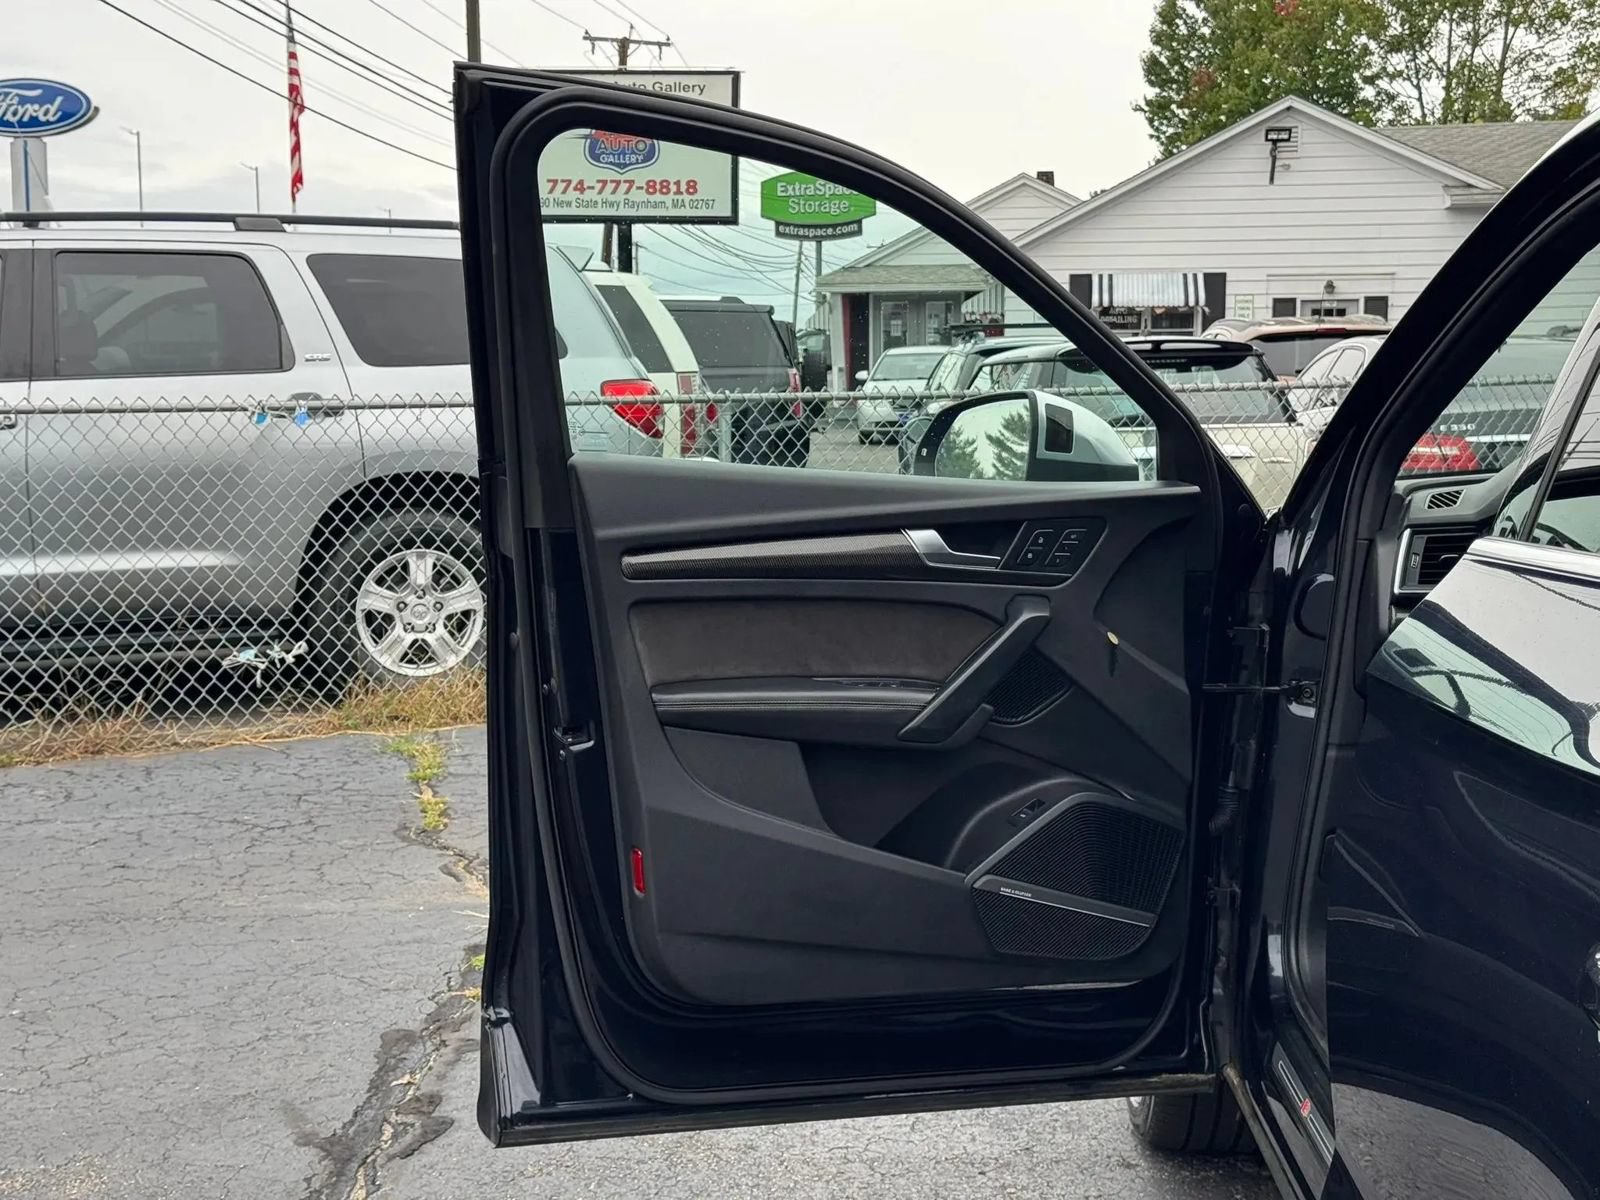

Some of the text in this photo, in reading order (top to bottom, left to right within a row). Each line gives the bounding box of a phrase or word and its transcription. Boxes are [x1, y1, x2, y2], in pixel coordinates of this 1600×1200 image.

[652, 81, 706, 95] Gallery
[0, 87, 63, 122] Ford
[595, 138, 649, 154] AUTO
[600, 154, 643, 163] GALLERY
[547, 179, 698, 195] 774-777-8818
[777, 181, 859, 198] ExtraSpac
[553, 197, 571, 208] New
[575, 197, 598, 208] State
[601, 198, 620, 211] Hwy
[623, 198, 669, 211] Raynham,
[671, 198, 686, 209] MA
[688, 198, 715, 209] 02767
[788, 198, 848, 215] Storage
[778, 223, 858, 237] extraspace.com
